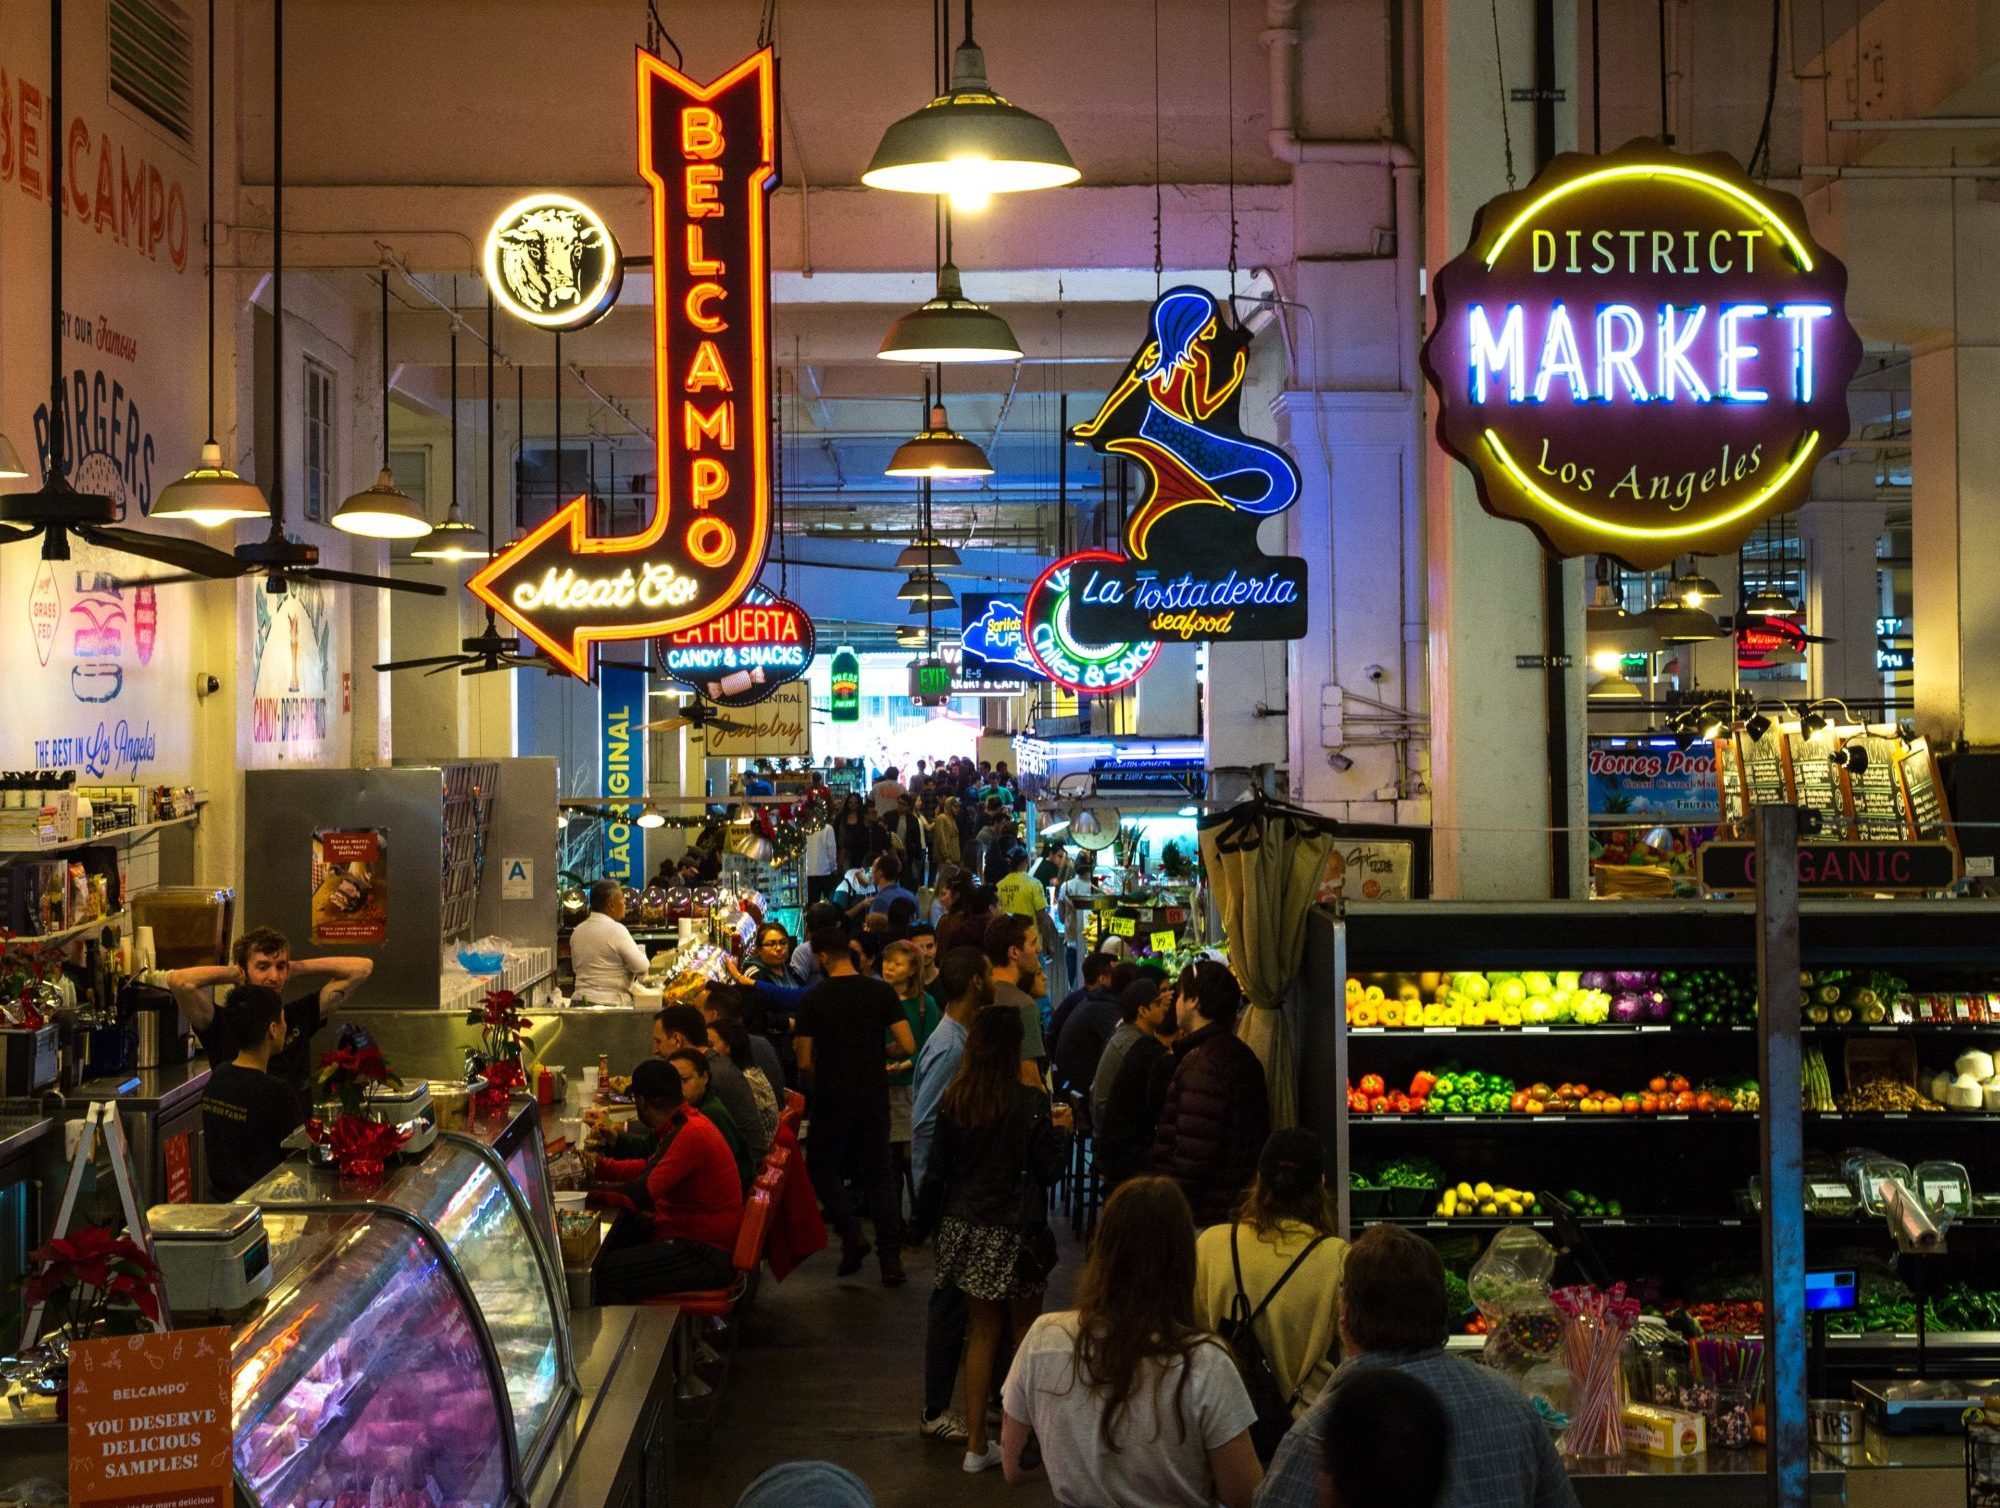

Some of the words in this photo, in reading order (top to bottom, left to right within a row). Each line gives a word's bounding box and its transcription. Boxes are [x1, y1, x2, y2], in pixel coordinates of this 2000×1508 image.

[1532, 229, 1764, 274] DISTRICT
[75, 314, 93, 345] OUR
[96, 314, 138, 363] Famous
[681, 107, 736, 567] BELCAMPO
[1470, 302, 1832, 404] MARKET
[1538, 438, 1595, 492] Los
[1609, 443, 1762, 511] Angeles
[513, 566, 635, 611] Meat
[1081, 569, 1126, 605] La
[34, 602, 56, 619] GRASS
[709, 609, 798, 643] HUERTA
[1151, 608, 1235, 640] seafood
[37, 622, 51, 640] FED
[667, 648, 722, 669] CANDY
[723, 646, 736, 668] &
[739, 645, 804, 666] SNACKS
[1033, 623, 1080, 683] Chiles
[1084, 664, 1106, 687] &
[1104, 640, 1157, 686] Spice
[919, 667, 947, 694] EXIT
[761, 693, 802, 704] ENTRAL
[253, 698, 278, 743] CANDY
[713, 711, 804, 748] Jewelry
[35, 740, 50, 769] THE
[53, 737, 72, 767] BEST
[75, 736, 84, 765] IN
[86, 721, 111, 778] Los
[113, 718, 156, 781] Angeles
[1590, 749, 1662, 777] Torres
[508, 860, 527, 881] A
[113, 1383, 186, 1401] BELCAMPO
[86, 1418, 123, 1437] YOU
[129, 1408, 217, 1433] DESERVE
[102, 1431, 201, 1458] DELICIOUS
[105, 1453, 198, 1479] SAMPLES!
[155, 1499, 177, 1508] more
[178, 1496, 215, 1508] delicious
